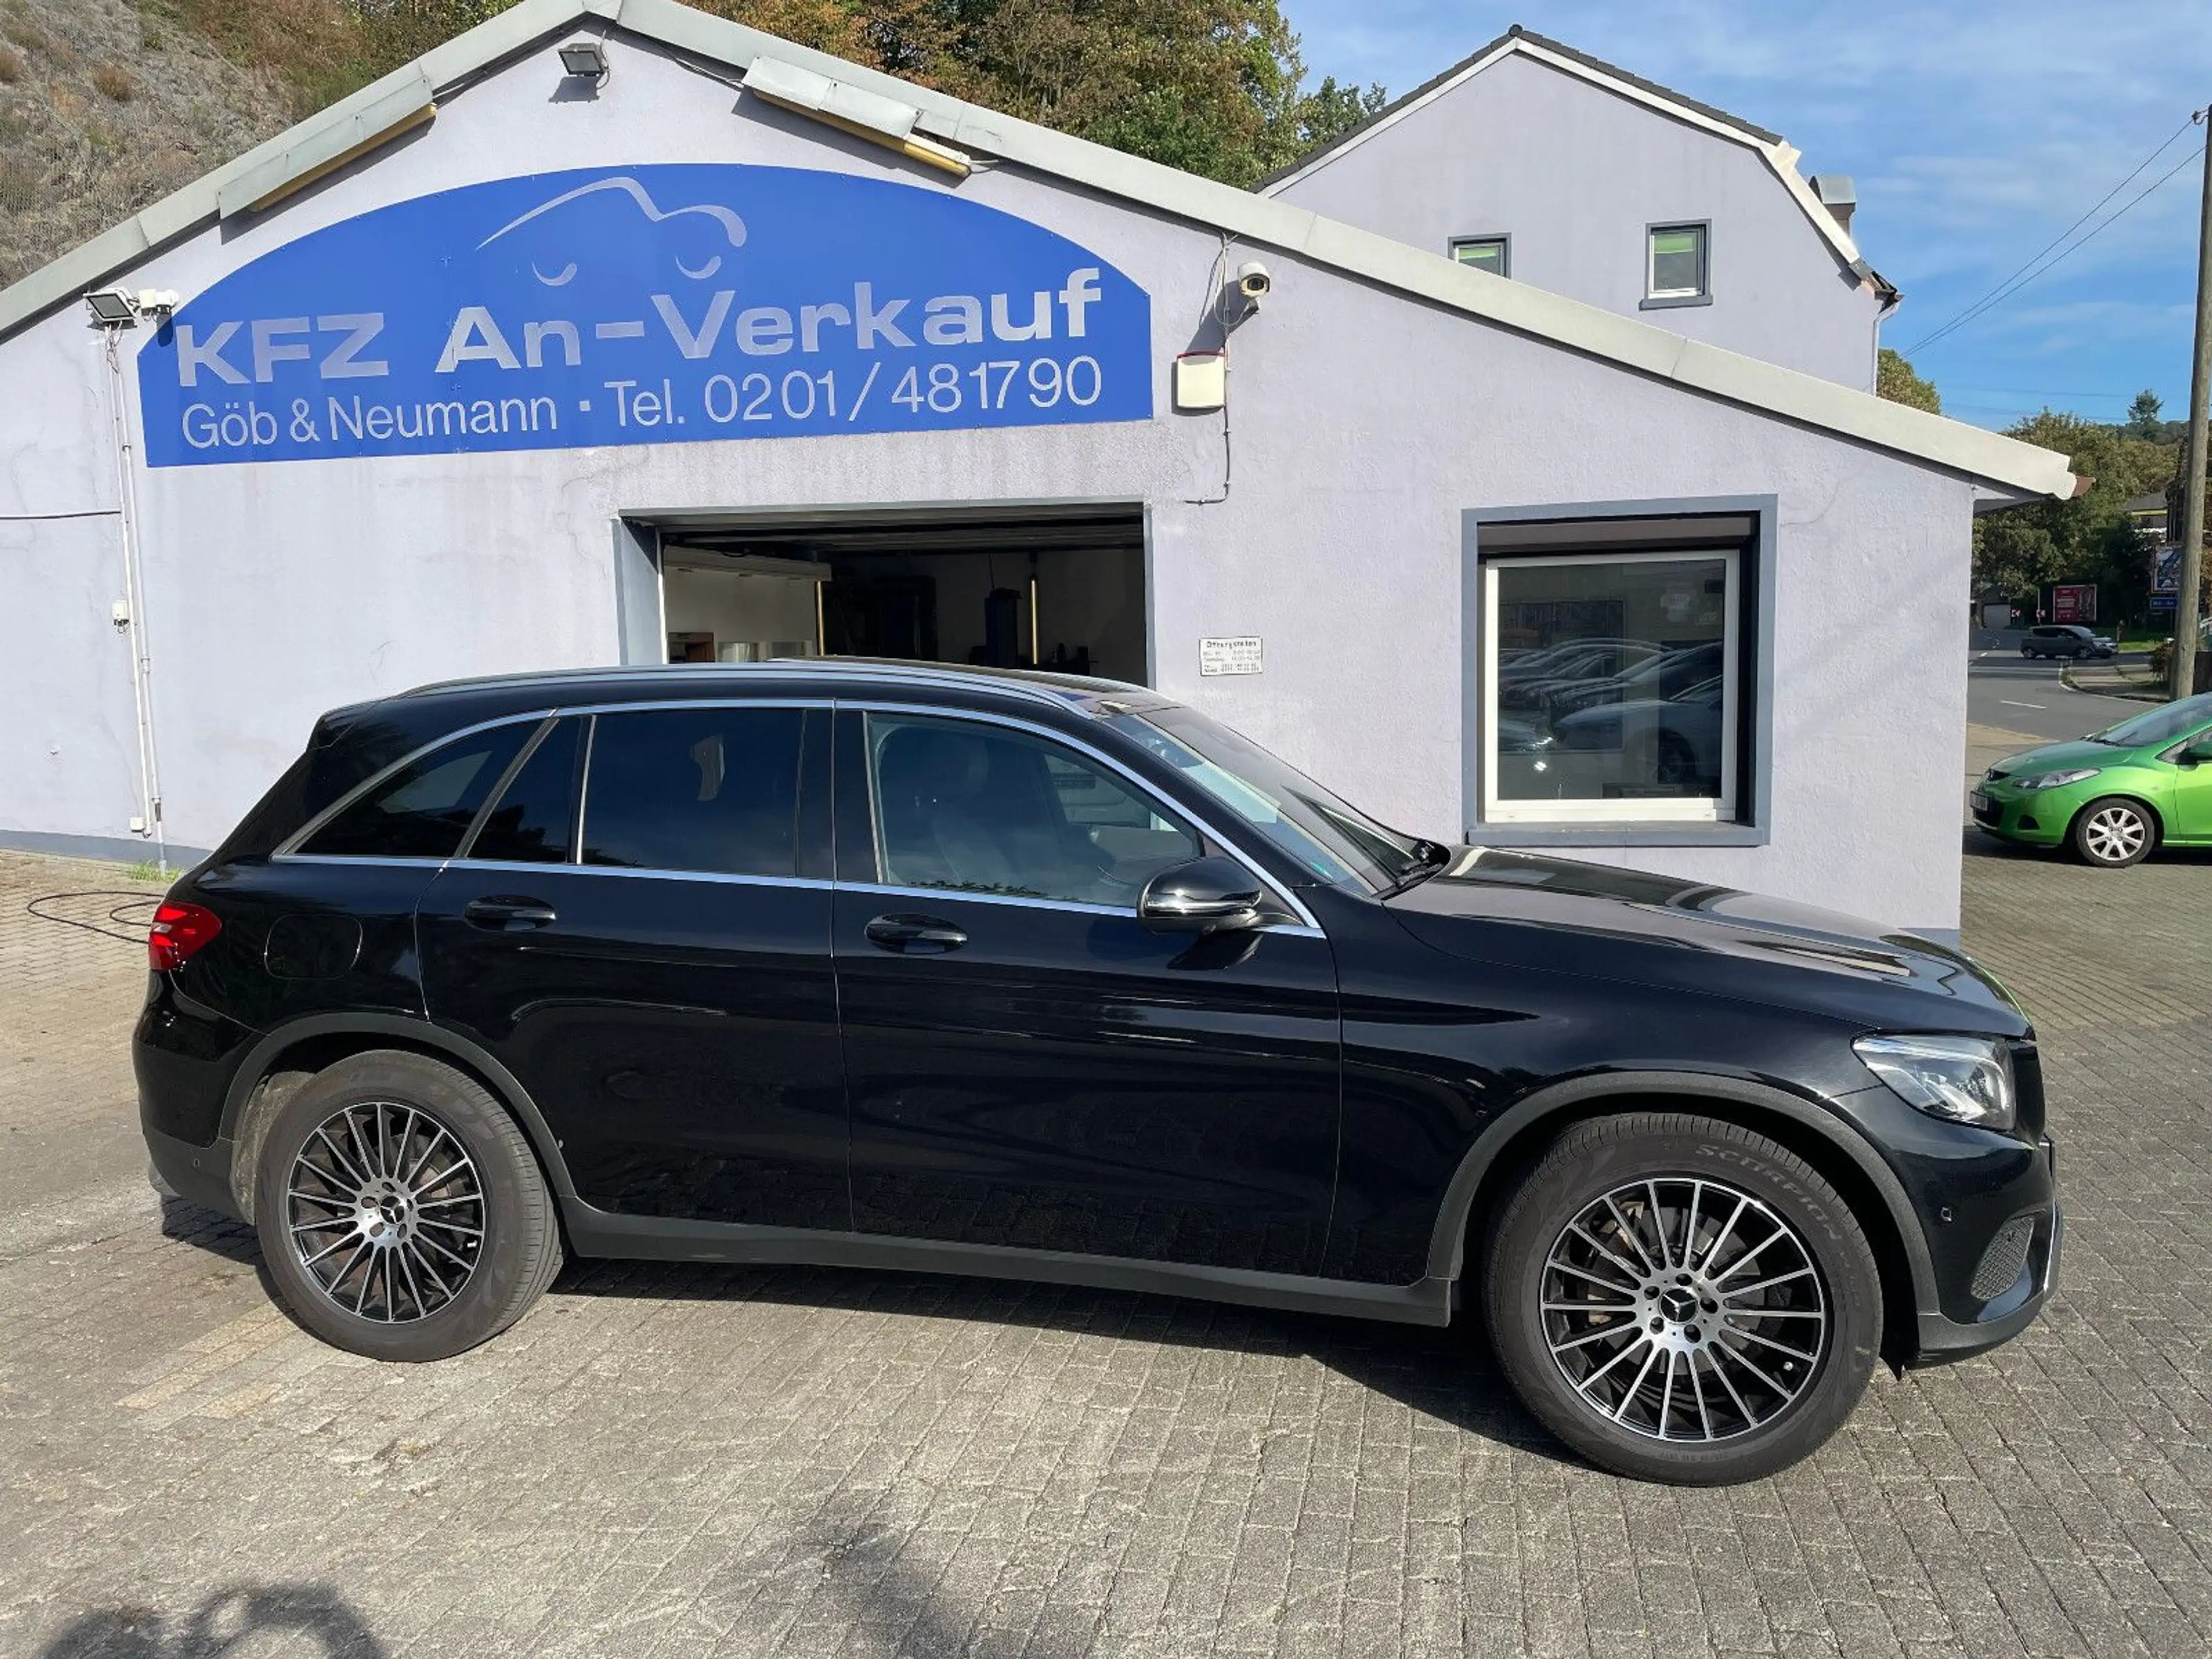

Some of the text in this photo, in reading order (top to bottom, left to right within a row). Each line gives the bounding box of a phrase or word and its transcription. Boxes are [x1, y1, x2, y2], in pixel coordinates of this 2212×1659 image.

[176, 312, 389, 387] KFZ
[183, 402, 278, 448] Göb
[290, 397, 320, 442] &
[329, 395, 557, 441] Neumann
[604, 380, 685, 428] Tel.
